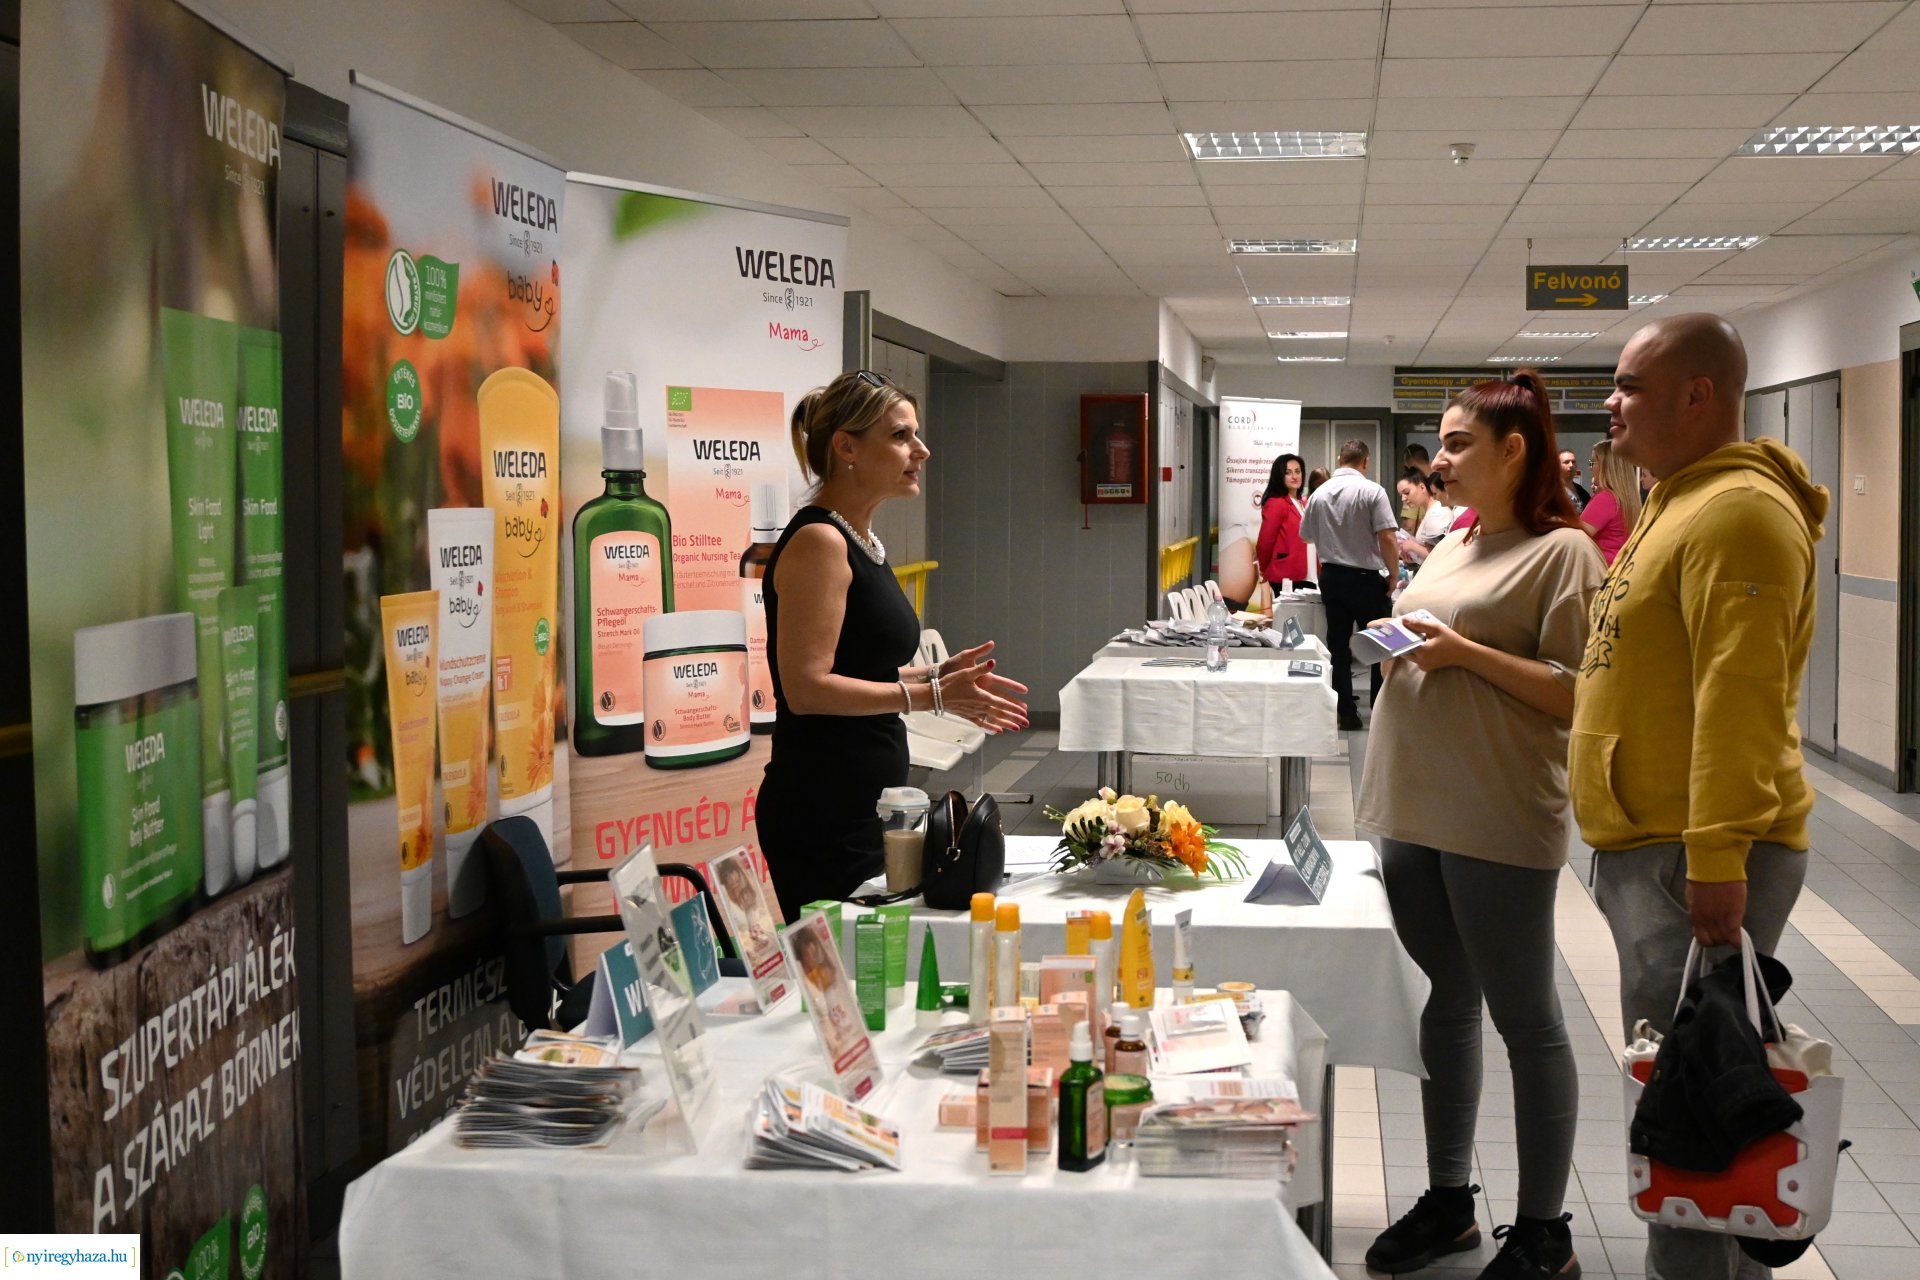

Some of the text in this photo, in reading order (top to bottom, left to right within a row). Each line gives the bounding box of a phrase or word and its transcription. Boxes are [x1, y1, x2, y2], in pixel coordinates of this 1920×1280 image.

[201, 82, 281, 171] WELEDA
[492, 176, 558, 234] WELEDA
[509, 233, 523, 249] Since
[424, 265, 448, 289] 100%
[735, 245, 836, 289] WELEDA
[507, 270, 543, 312] baby
[1533, 271, 1621, 290] Felvonó
[762, 291, 813, 307] Since 1921
[768, 321, 809, 342] Mama
[179, 397, 225, 429] WELEDA
[238, 406, 279, 433] WELEDA
[1227, 416, 1251, 424] CORD
[693, 439, 761, 461] WELEDA
[493, 450, 547, 478] WELEDA
[715, 488, 742, 500] Mama
[504, 516, 534, 543] baby
[673, 534, 722, 547] Bio Stilltee
[439, 544, 483, 568] WELEDA
[604, 544, 649, 559] WELEDA
[673, 553, 699, 564] Organic
[702, 552, 728, 563] Nursing
[618, 573, 639, 582] Mama
[448, 597, 473, 616] baby
[596, 604, 657, 617] Schwangerschafts-
[597, 616, 627, 629] Pflegeöl
[223, 625, 255, 646] WELEDA
[396, 624, 430, 647] WELEDA
[673, 662, 718, 679] WELEDA
[125, 732, 166, 774] WELEDA
[1155, 771, 1173, 785] 50
[595, 795, 731, 860] GYENGÉD
[414, 954, 509, 1042] TERMÉSZ
[100, 923, 297, 1123] SZUPERTÁPLÁLÉK
[396, 1022, 492, 1120] VÉDELEM
[93, 1006, 302, 1234] A SZÁRAZ BŐRNEK
